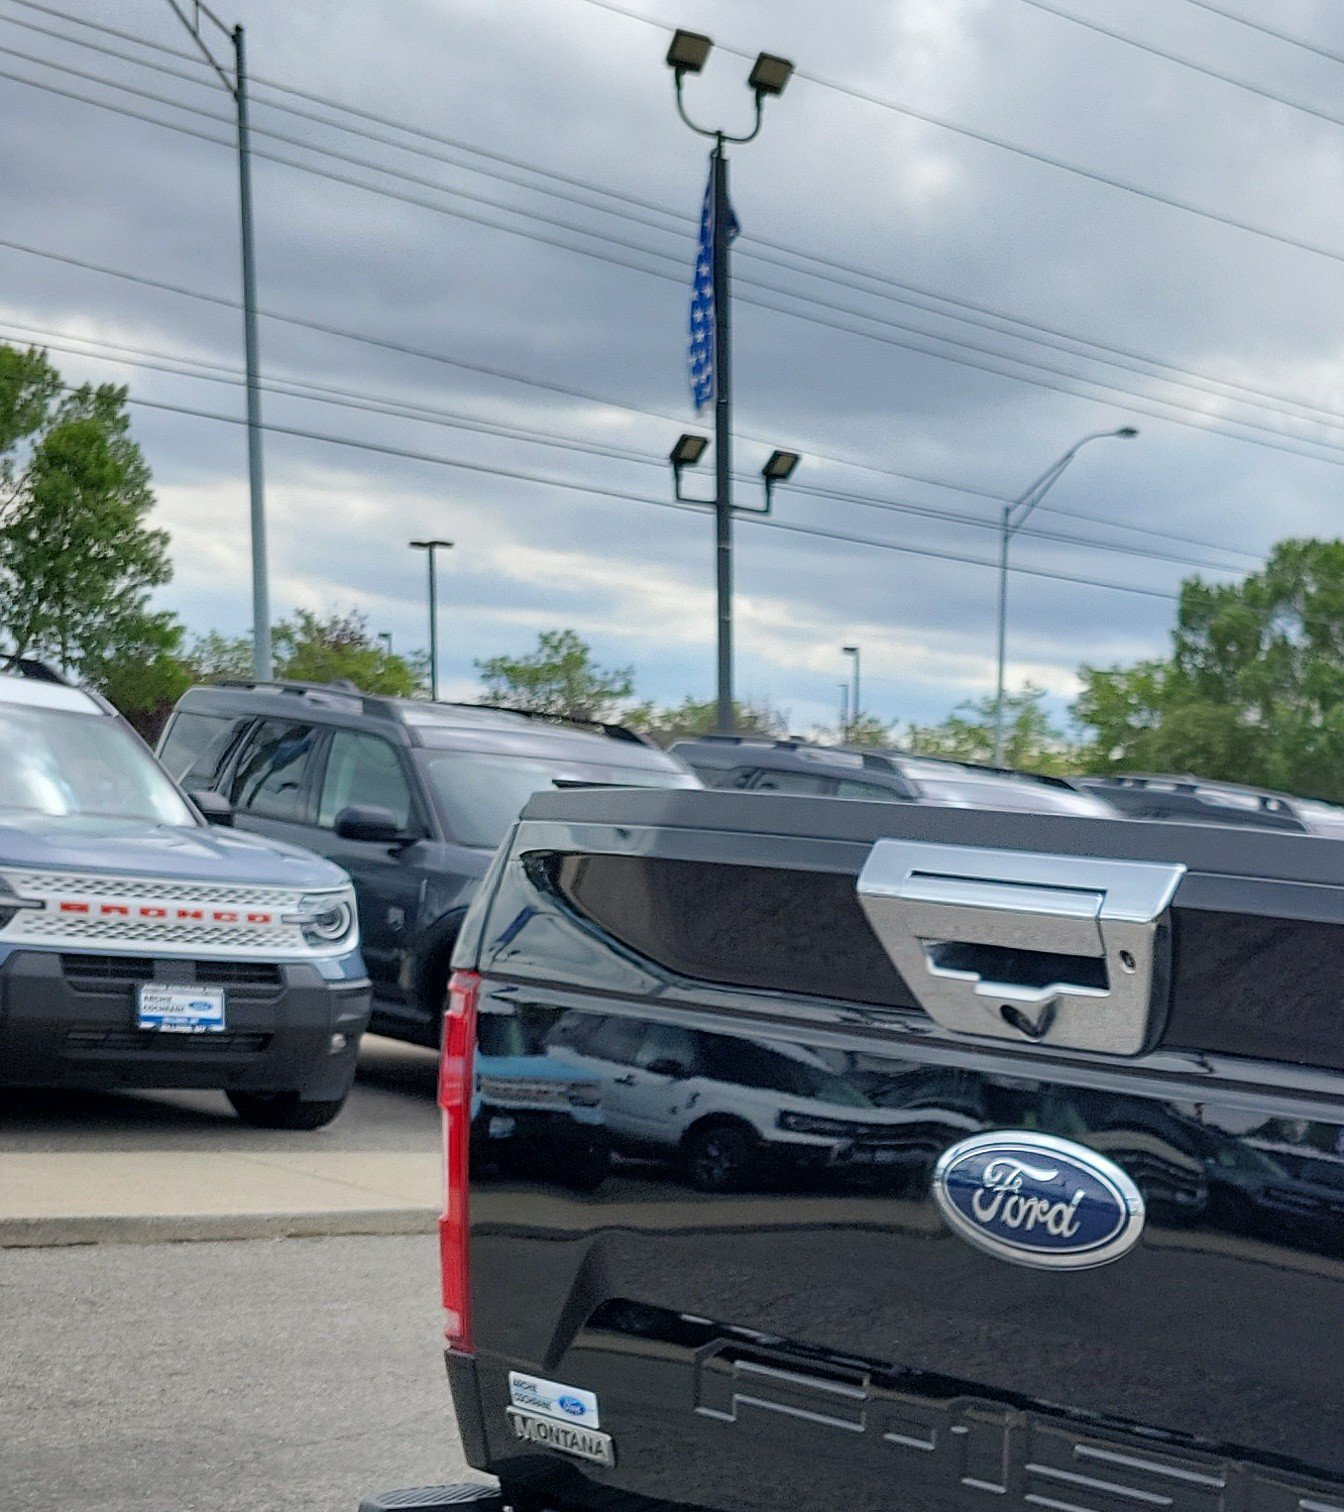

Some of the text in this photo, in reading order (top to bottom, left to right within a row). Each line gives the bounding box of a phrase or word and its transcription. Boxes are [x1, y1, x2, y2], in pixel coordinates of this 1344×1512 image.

[60, 902, 271, 923] BRONCO
[972, 1157, 1087, 1239] Ford
[510, 1411, 607, 1458] MONTANA
